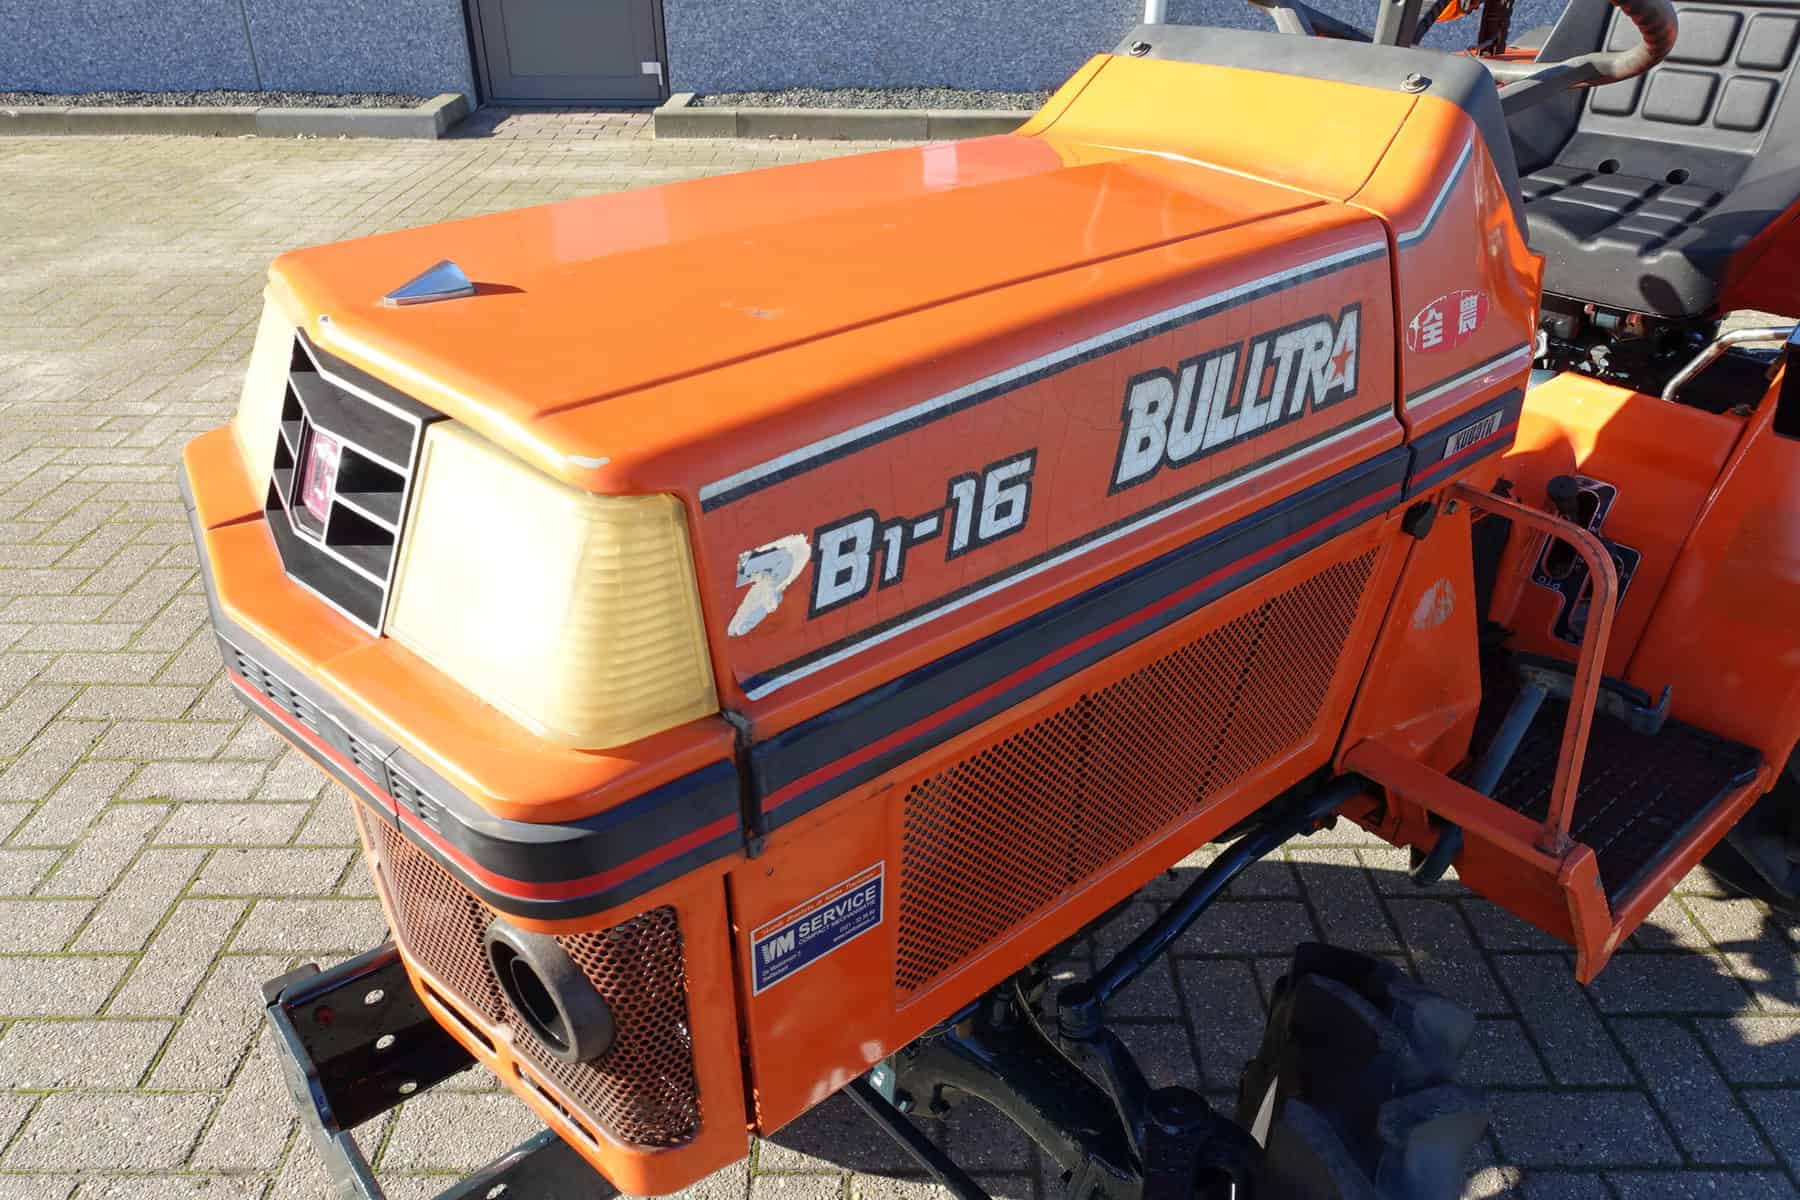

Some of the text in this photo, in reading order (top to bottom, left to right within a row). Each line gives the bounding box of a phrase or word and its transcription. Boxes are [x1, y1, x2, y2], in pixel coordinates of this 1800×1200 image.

[1110, 303, 1361, 492] BULLTRA
[760, 929, 795, 965] VM
[799, 884, 877, 938] SERVICE
